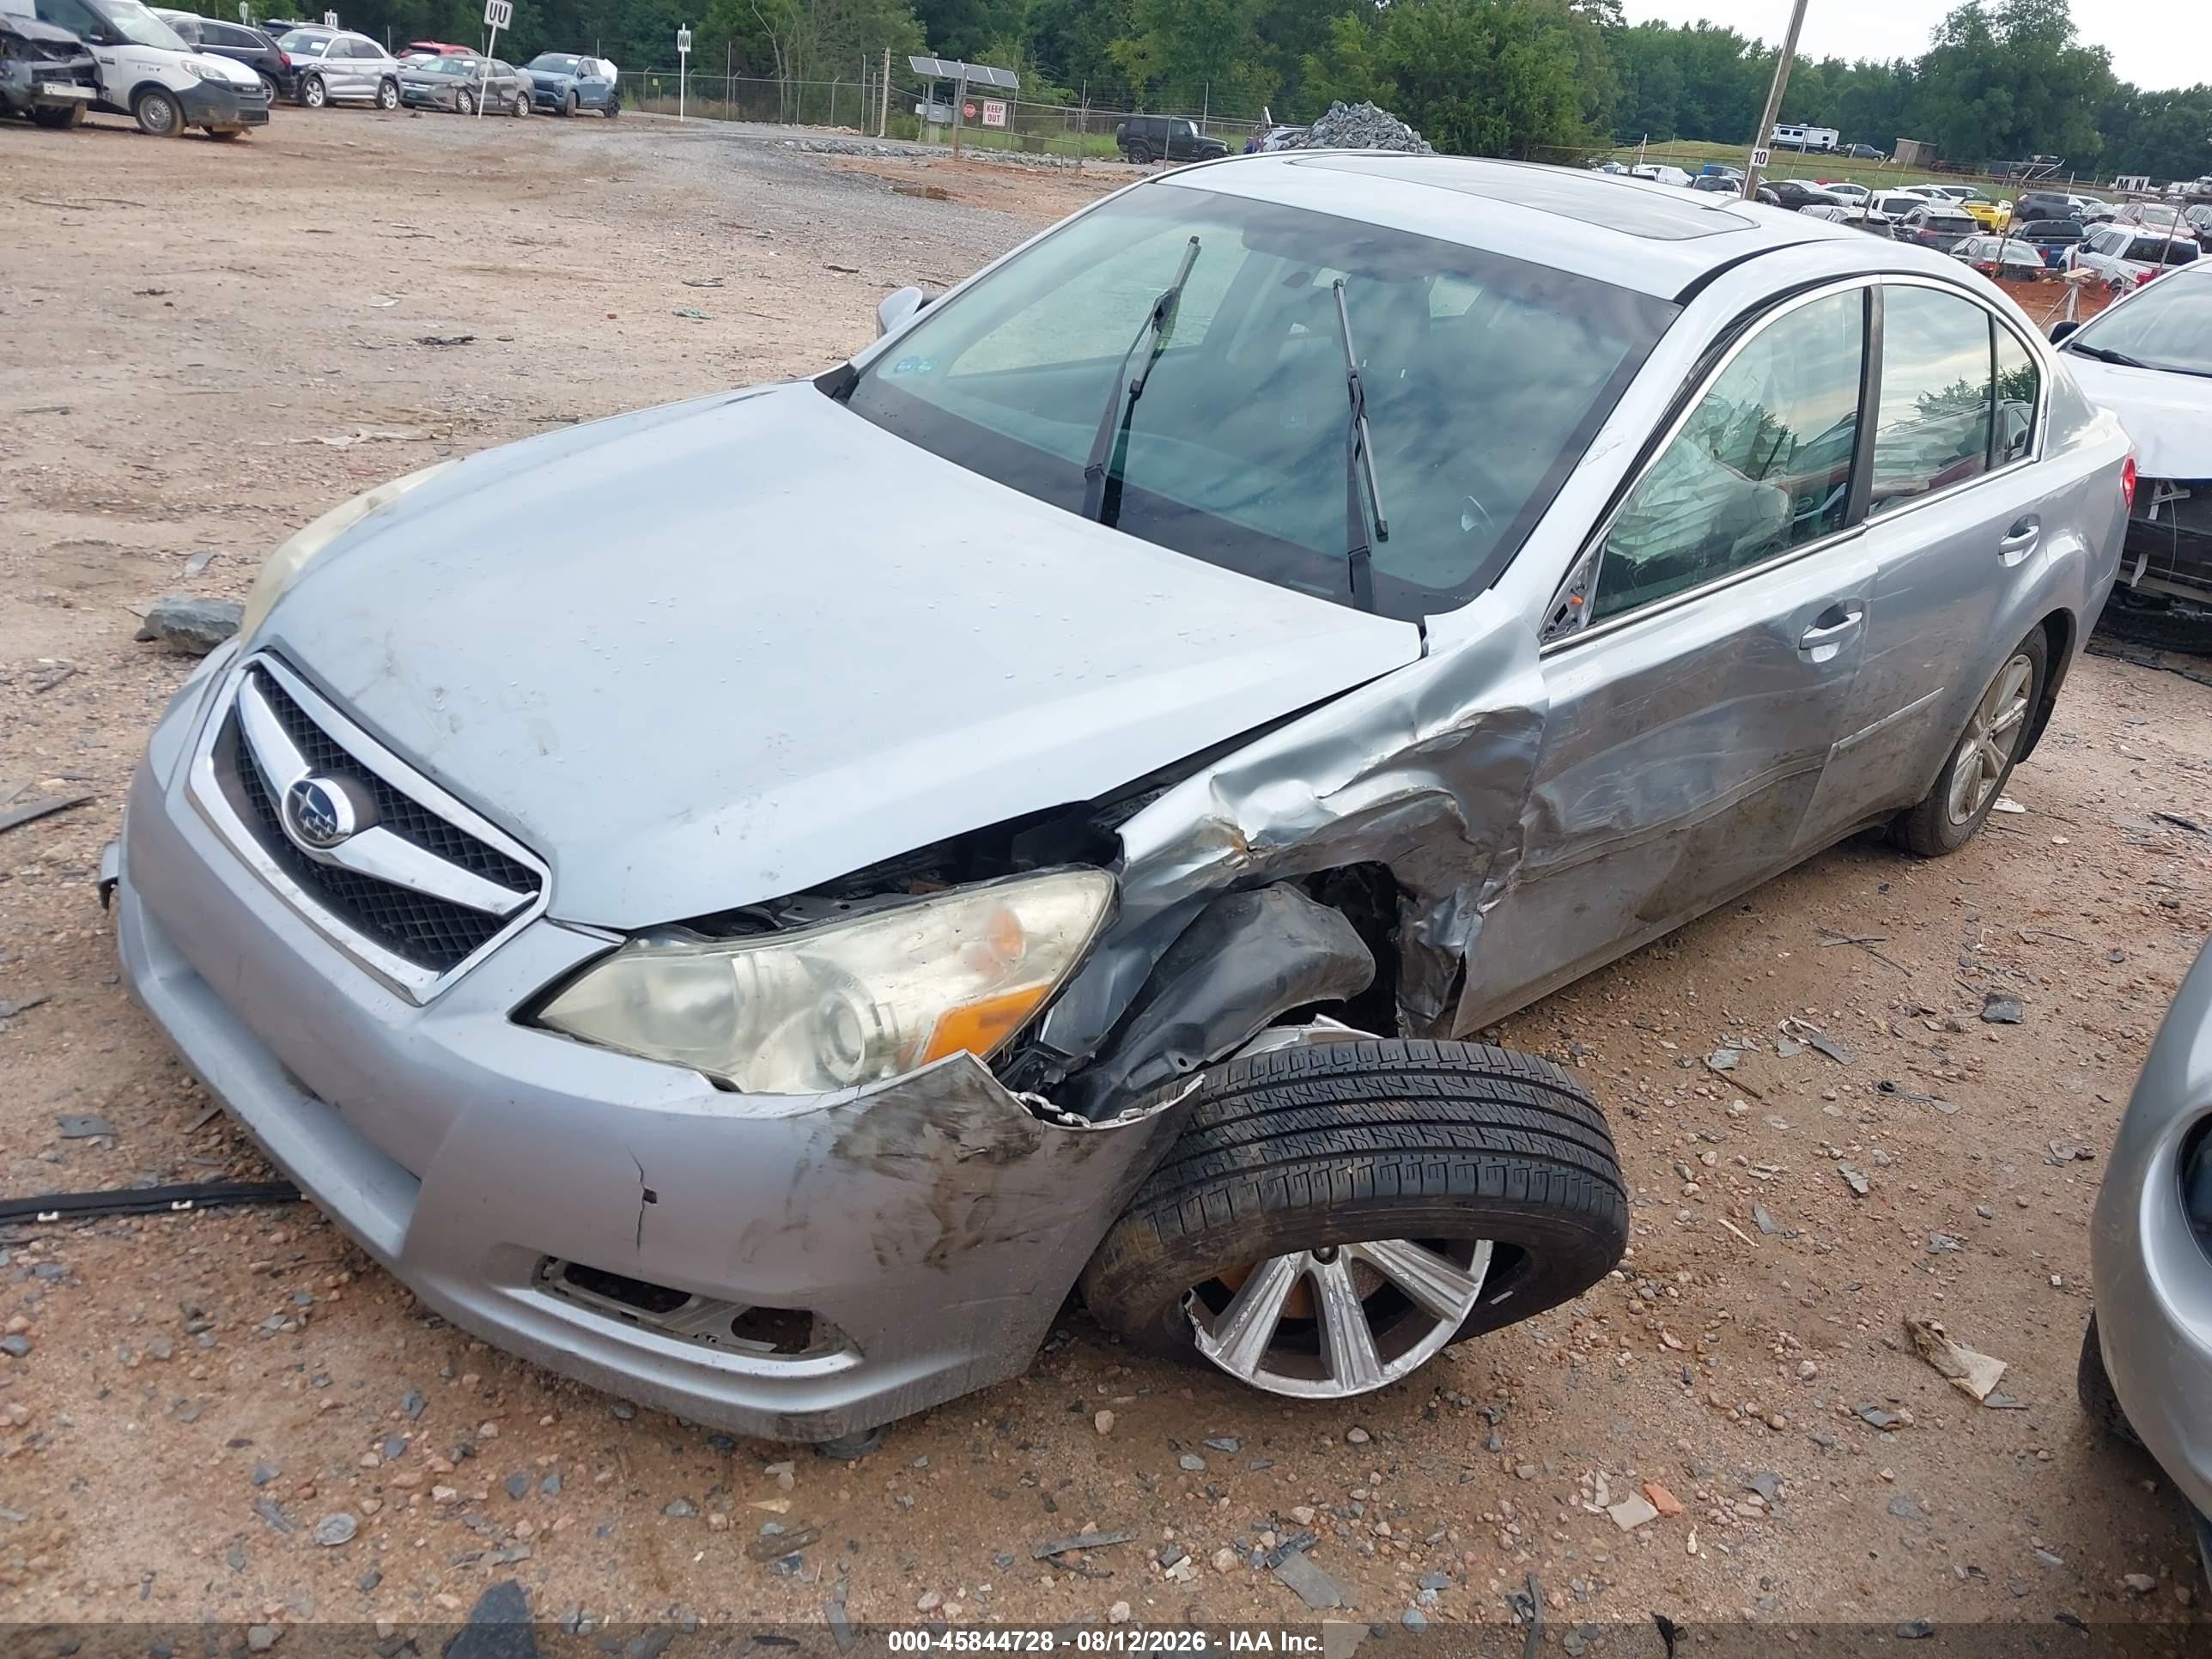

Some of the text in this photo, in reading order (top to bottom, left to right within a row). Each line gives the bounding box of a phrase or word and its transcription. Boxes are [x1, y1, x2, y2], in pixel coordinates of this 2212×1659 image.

[489, 2, 508, 23] UU
[987, 103, 1004, 112] KEEP
[988, 114, 1000, 123] OUT
[1753, 150, 1767, 164] 10
